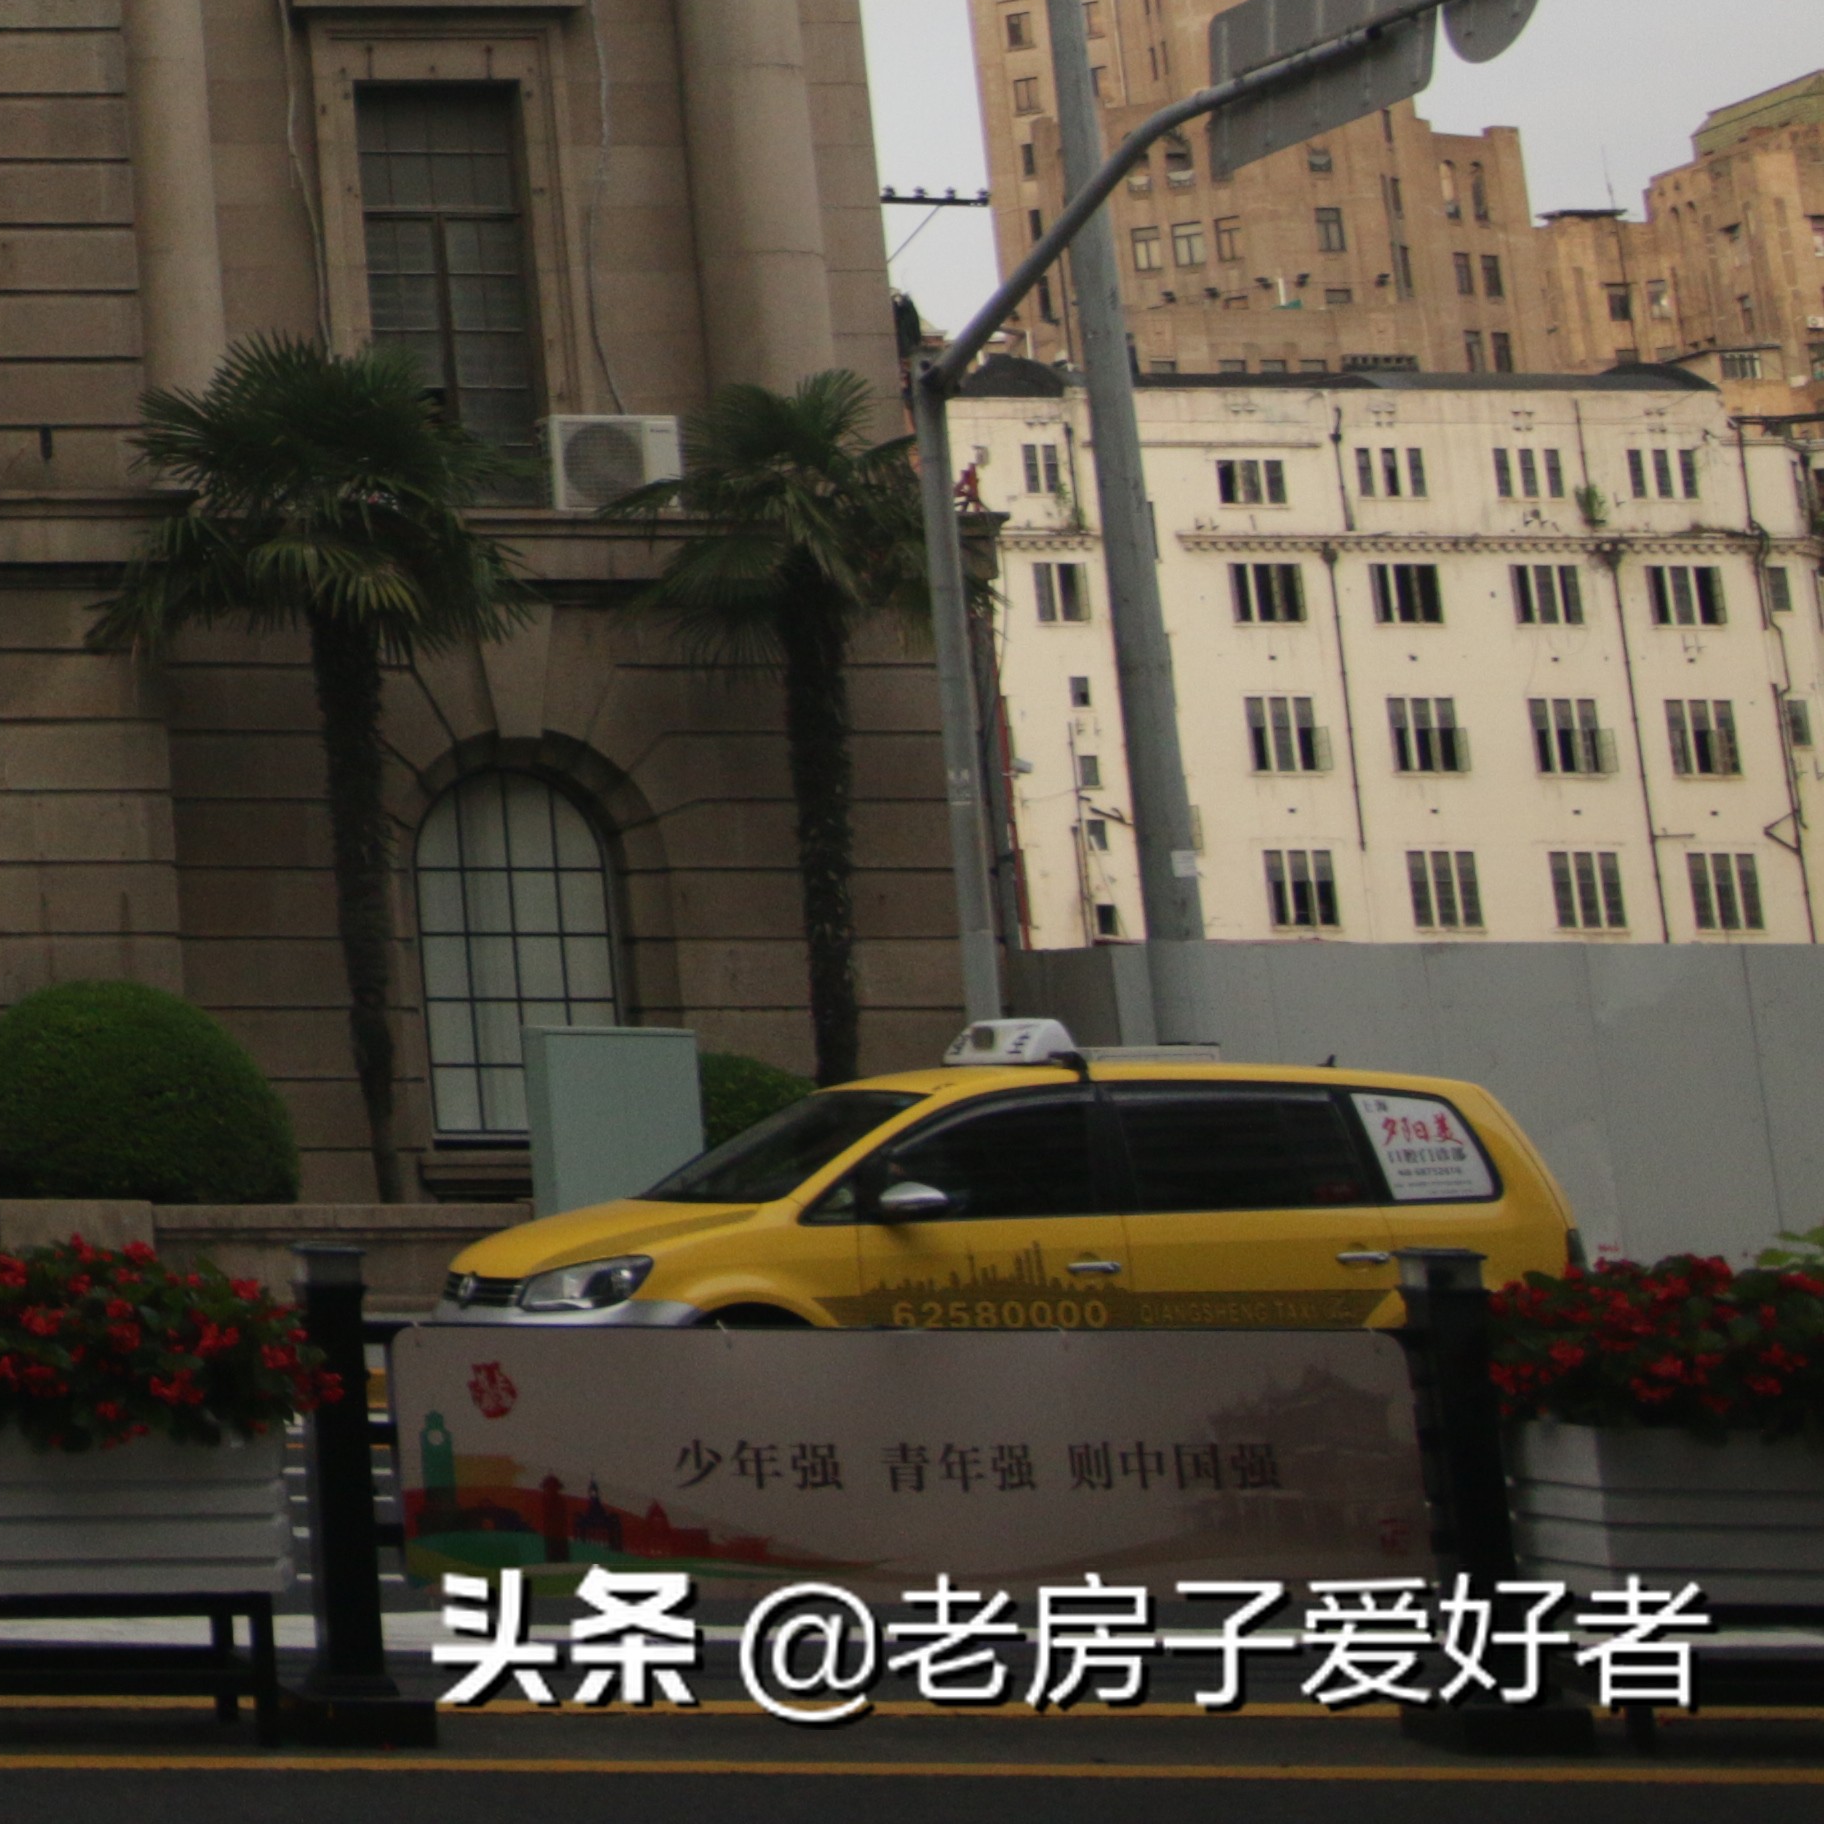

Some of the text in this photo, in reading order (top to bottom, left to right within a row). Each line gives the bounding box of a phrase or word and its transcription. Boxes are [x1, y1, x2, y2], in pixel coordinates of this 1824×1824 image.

[892, 1300, 1109, 1329] 62580000
[1139, 1301, 1316, 1324] QIANGSHENG TAXI
[673, 1435, 1282, 1493] 少年强 青年强 则中国强
